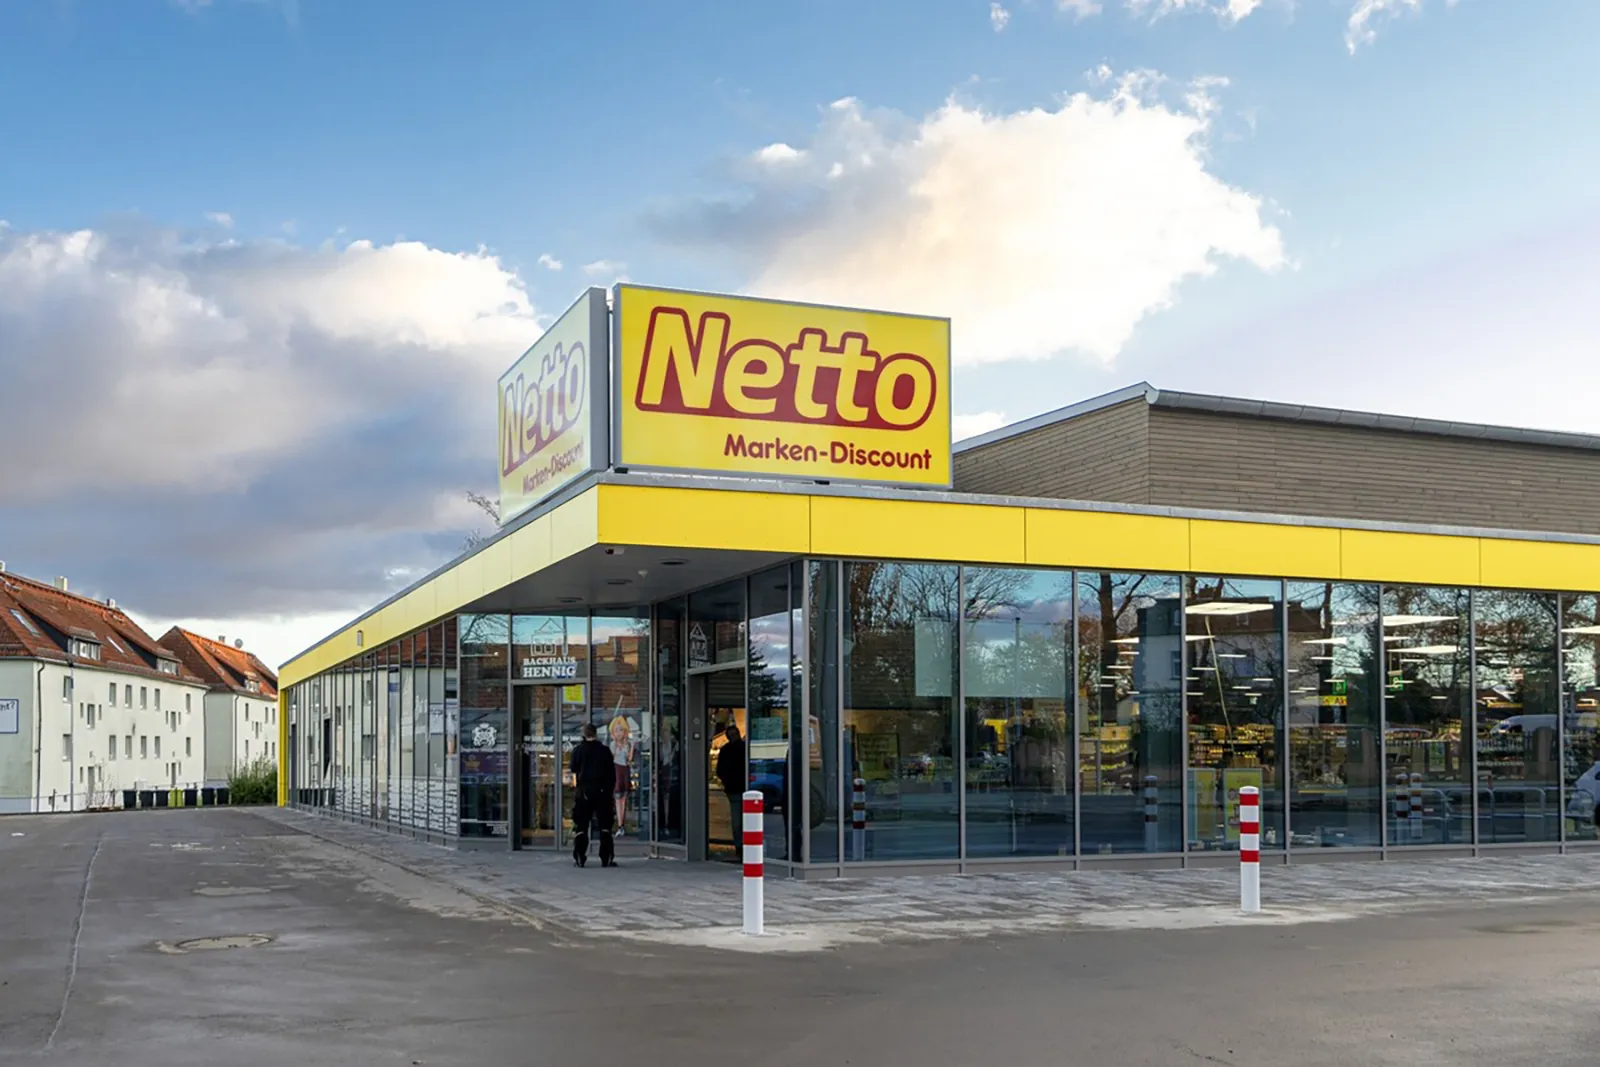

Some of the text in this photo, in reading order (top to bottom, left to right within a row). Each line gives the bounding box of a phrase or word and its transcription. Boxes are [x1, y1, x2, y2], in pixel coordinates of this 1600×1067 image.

[635, 306, 937, 431] Netto
[502, 340, 585, 478] Netto
[522, 436, 584, 496] Marken-Discount
[724, 434, 932, 470] Marken-Discount
[523, 656, 576, 666] BACKHAUS
[523, 666, 577, 678] HENNIG
